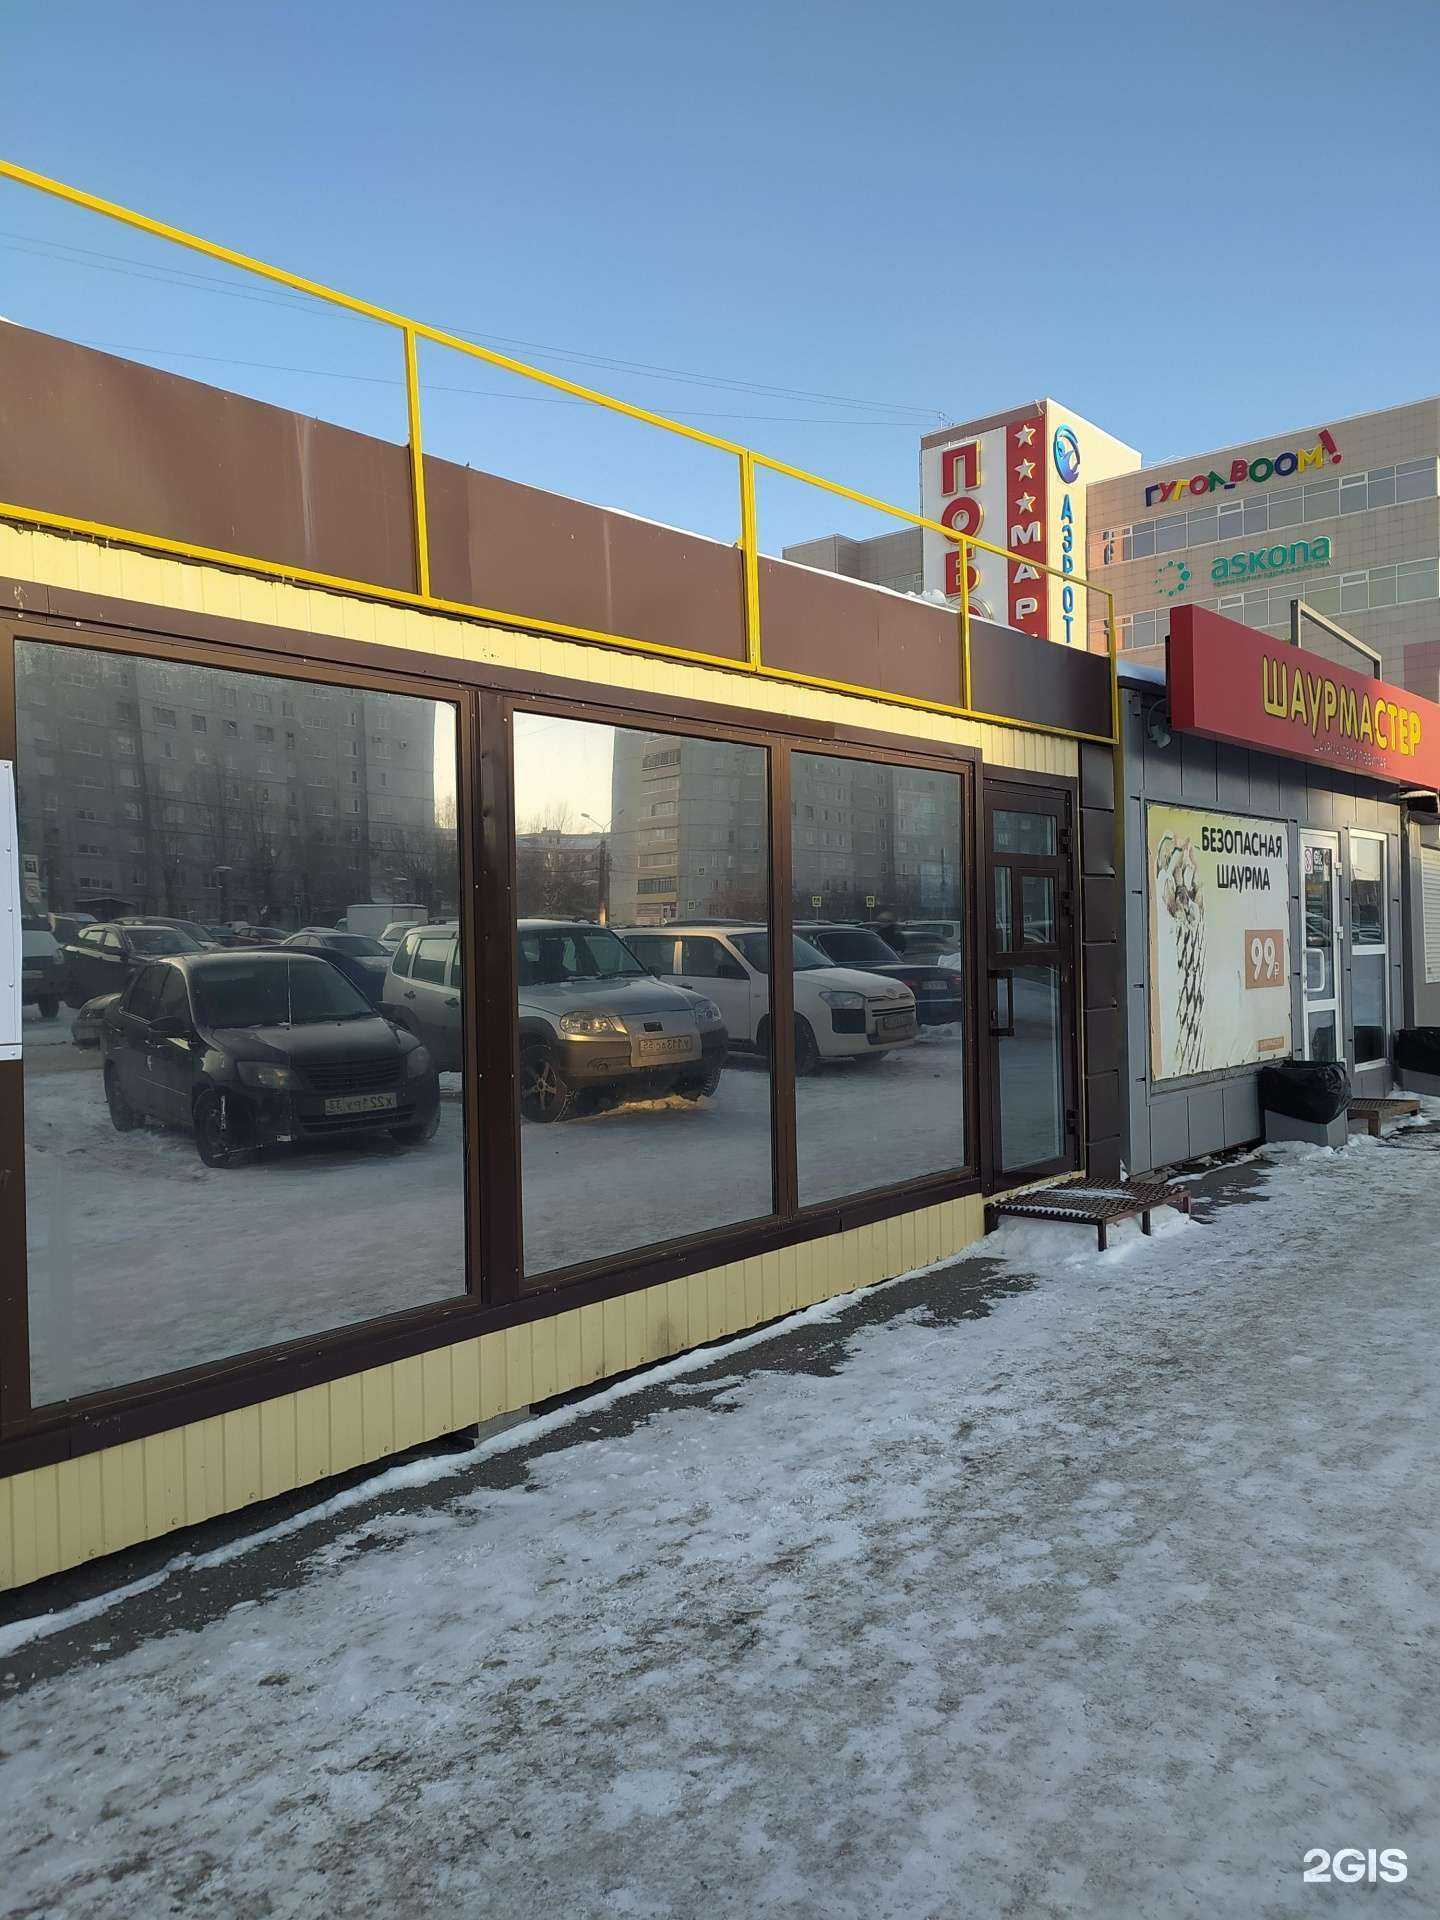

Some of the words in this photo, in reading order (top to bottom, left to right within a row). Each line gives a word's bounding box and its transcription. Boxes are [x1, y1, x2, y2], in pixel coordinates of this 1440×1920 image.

[941, 439, 992, 617] ПОБ
[1211, 535, 1333, 581] askona
[1011, 520, 1041, 638] МАР
[1262, 654, 1422, 757] ШАУРМАСТЕР
[1201, 825, 1284, 858] БЕЗОПАСНАЯ
[1217, 863, 1271, 894] ШАУРМА
